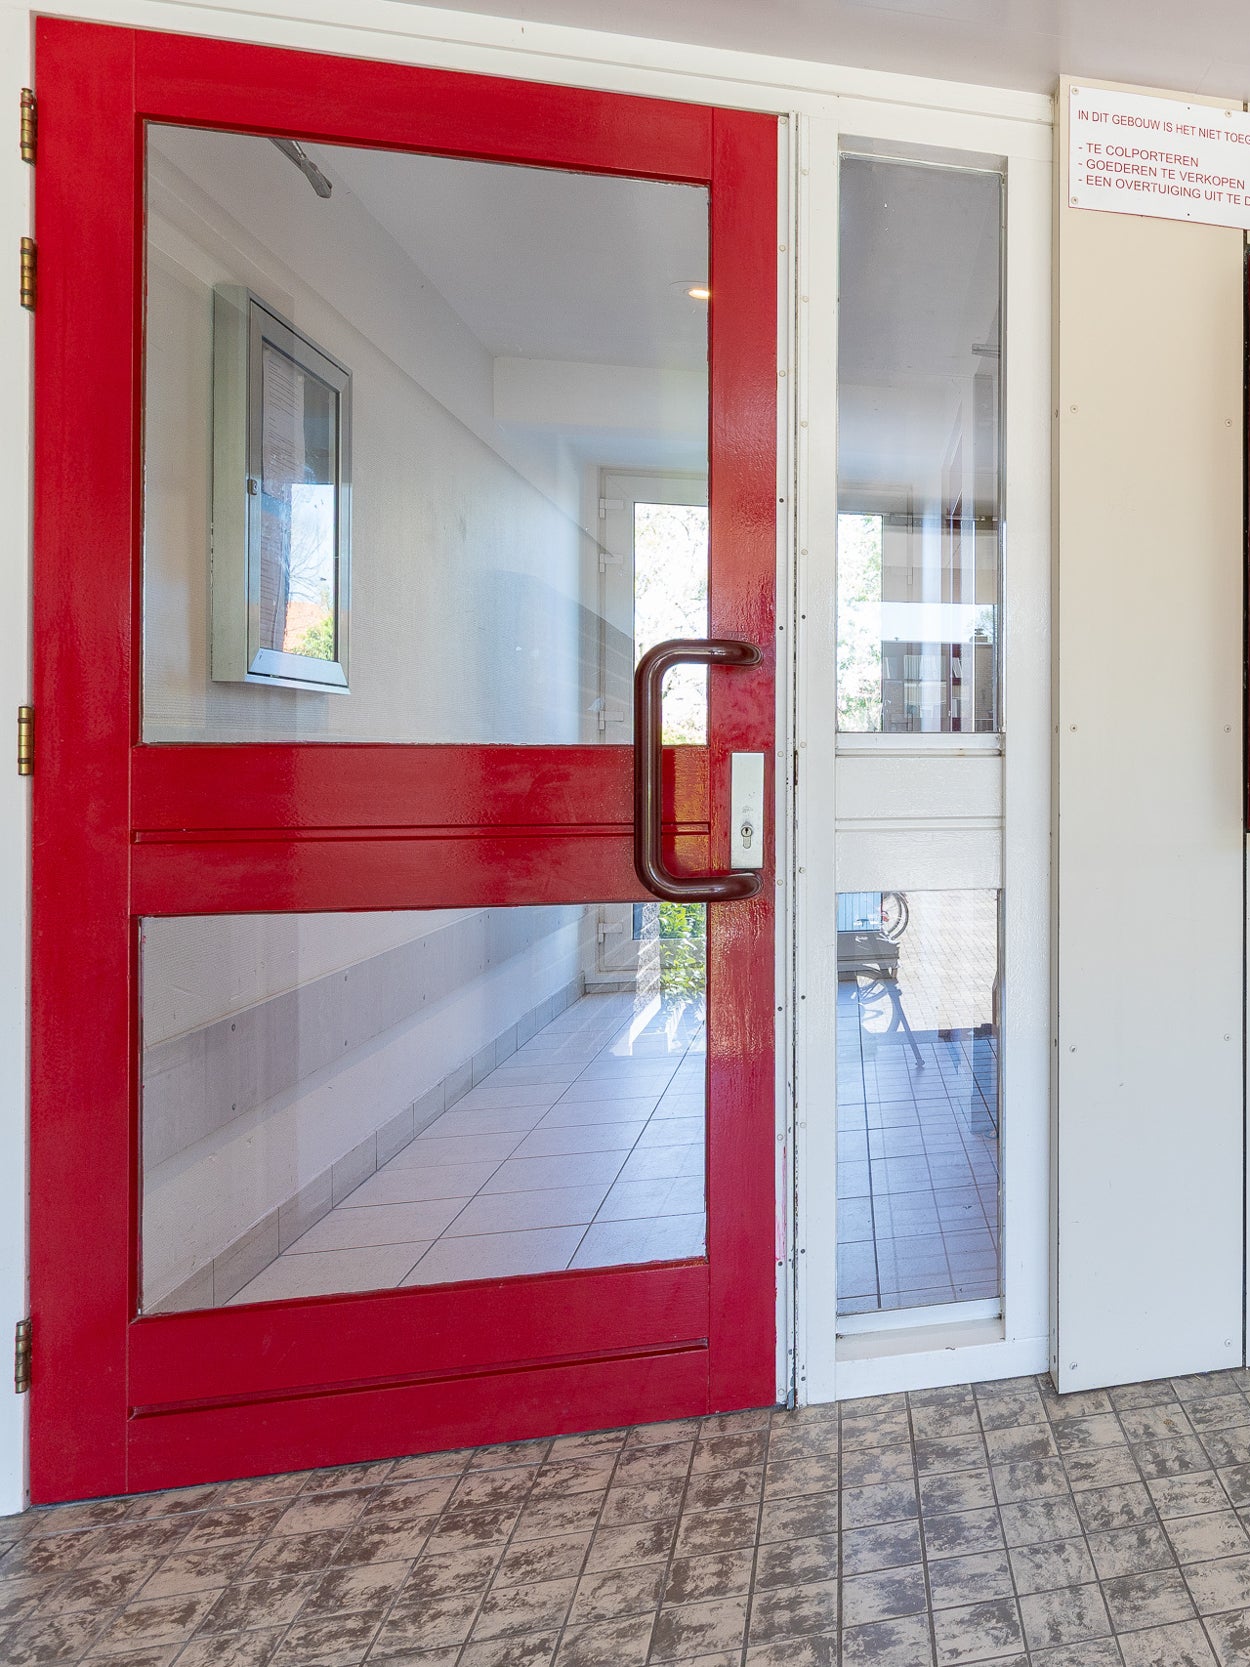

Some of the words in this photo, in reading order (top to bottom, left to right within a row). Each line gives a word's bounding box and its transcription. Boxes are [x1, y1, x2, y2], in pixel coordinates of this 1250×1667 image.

[1078, 110, 1089, 120] IN
[1092, 112, 1109, 123] DIT
[1112, 115, 1160, 130] GEBOUW
[1164, 122, 1173, 132] IS
[1176, 124, 1196, 136] HET
[1199, 128, 1221, 140] NIET
[1087, 143, 1101, 154] TE
[1106, 145, 1199, 167] COLPORTEREN
[1086, 160, 1157, 177] GOEDEREN
[1161, 169, 1176, 180] TE
[1179, 171, 1245, 190] VERKOPEN
[1086, 175, 1112, 188] EEN
[1116, 179, 1201, 199] OVERTUIGING
[1205, 190, 1223, 202] UIT
[1226, 194, 1241, 205] TE
